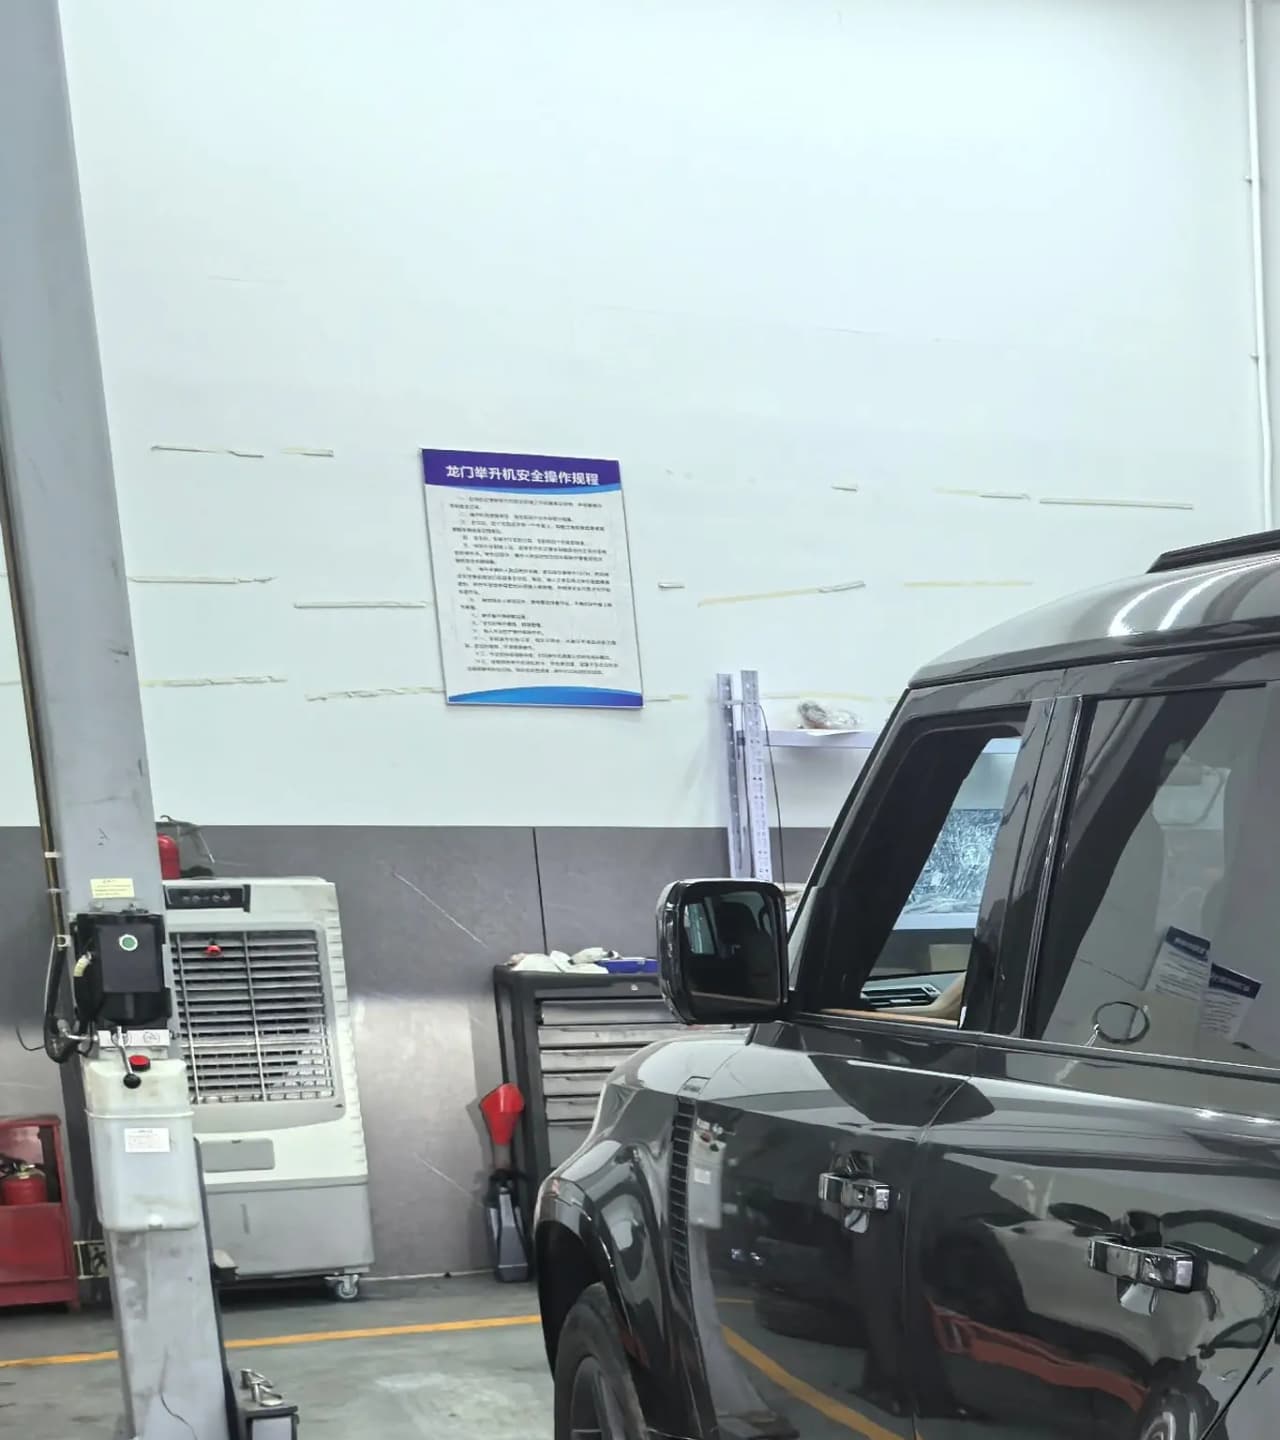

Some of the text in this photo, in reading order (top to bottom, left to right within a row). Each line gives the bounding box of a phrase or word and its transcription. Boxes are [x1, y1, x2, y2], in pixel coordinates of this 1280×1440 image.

[445, 465, 599, 486] 龙门举升机安全操作规程
